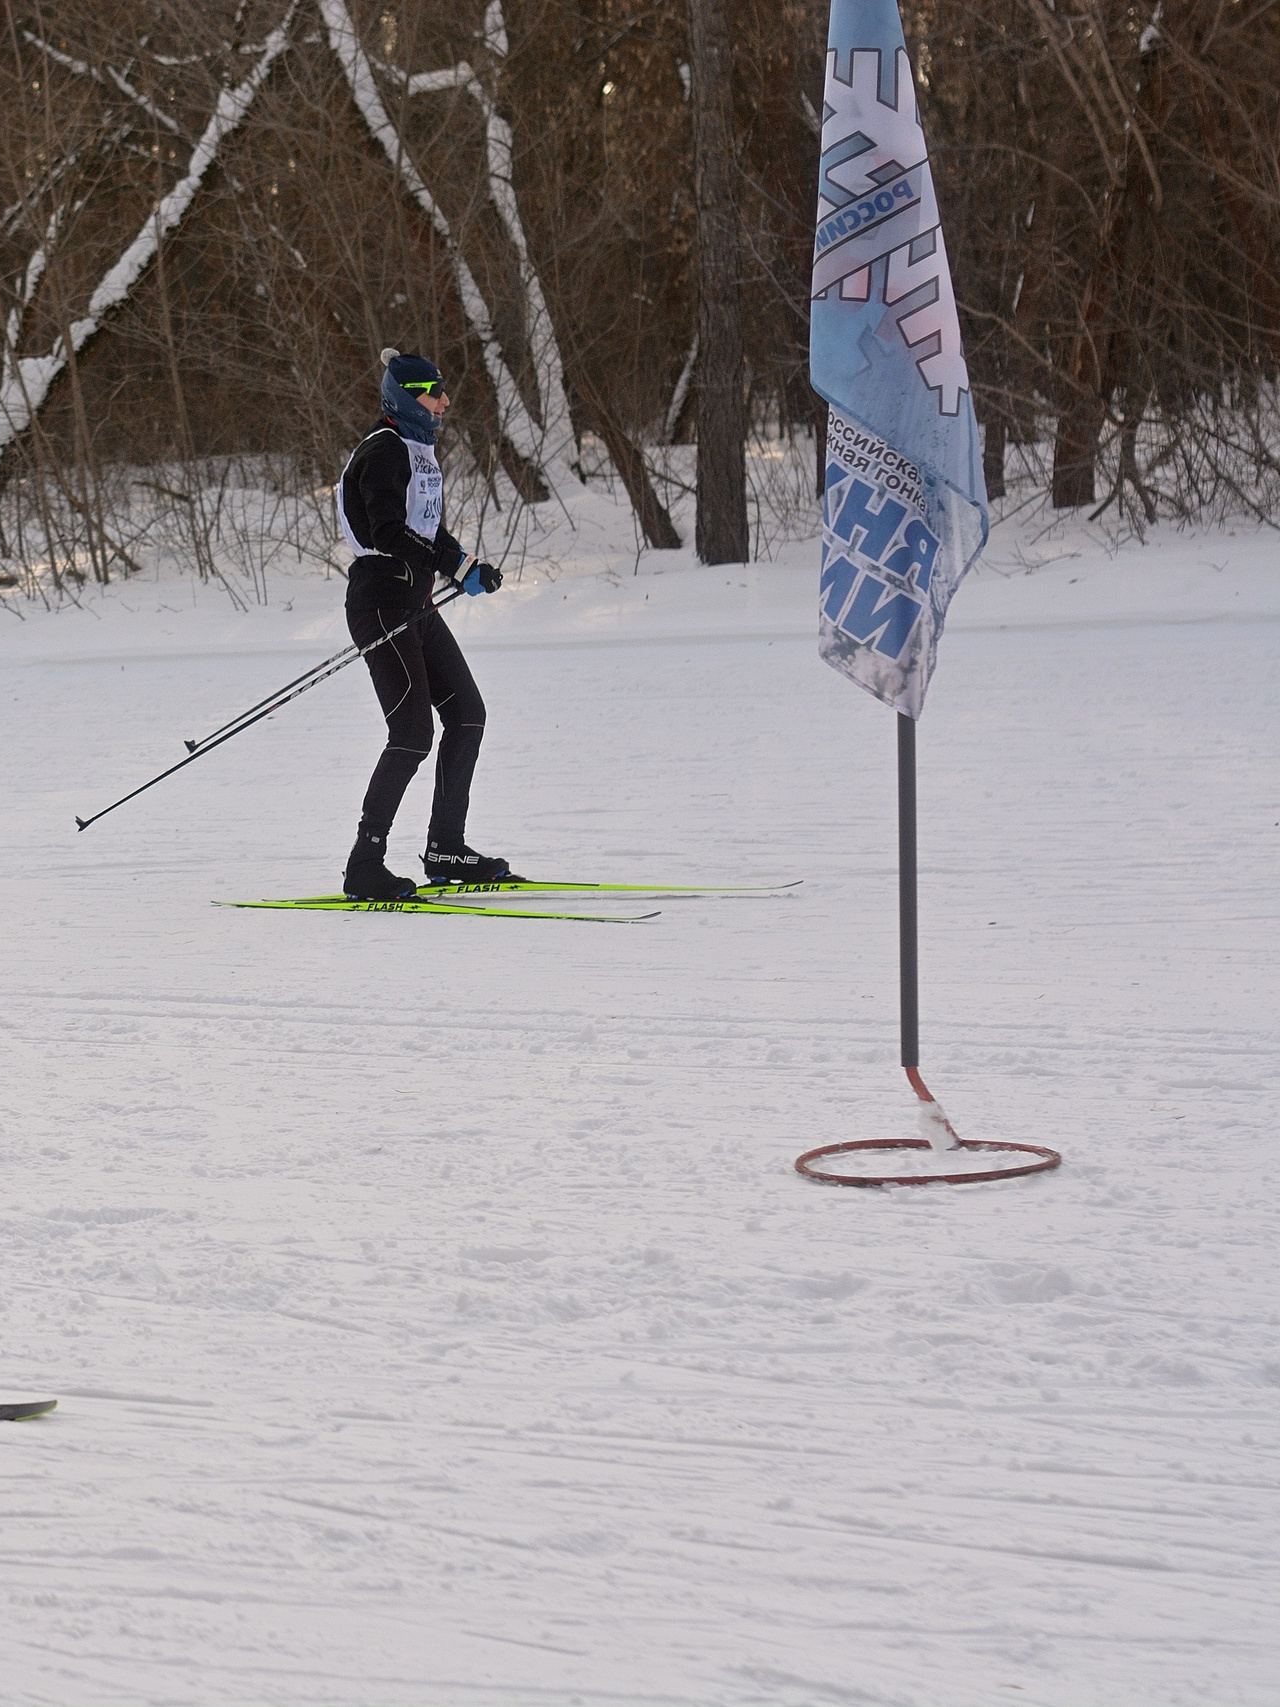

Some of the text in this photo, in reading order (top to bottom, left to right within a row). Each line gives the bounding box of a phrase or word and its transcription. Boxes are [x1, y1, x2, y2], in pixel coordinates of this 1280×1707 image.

[427, 852, 480, 864] SPINE
[457, 884, 501, 893] FLASH
[366, 903, 404, 911] FLASH
